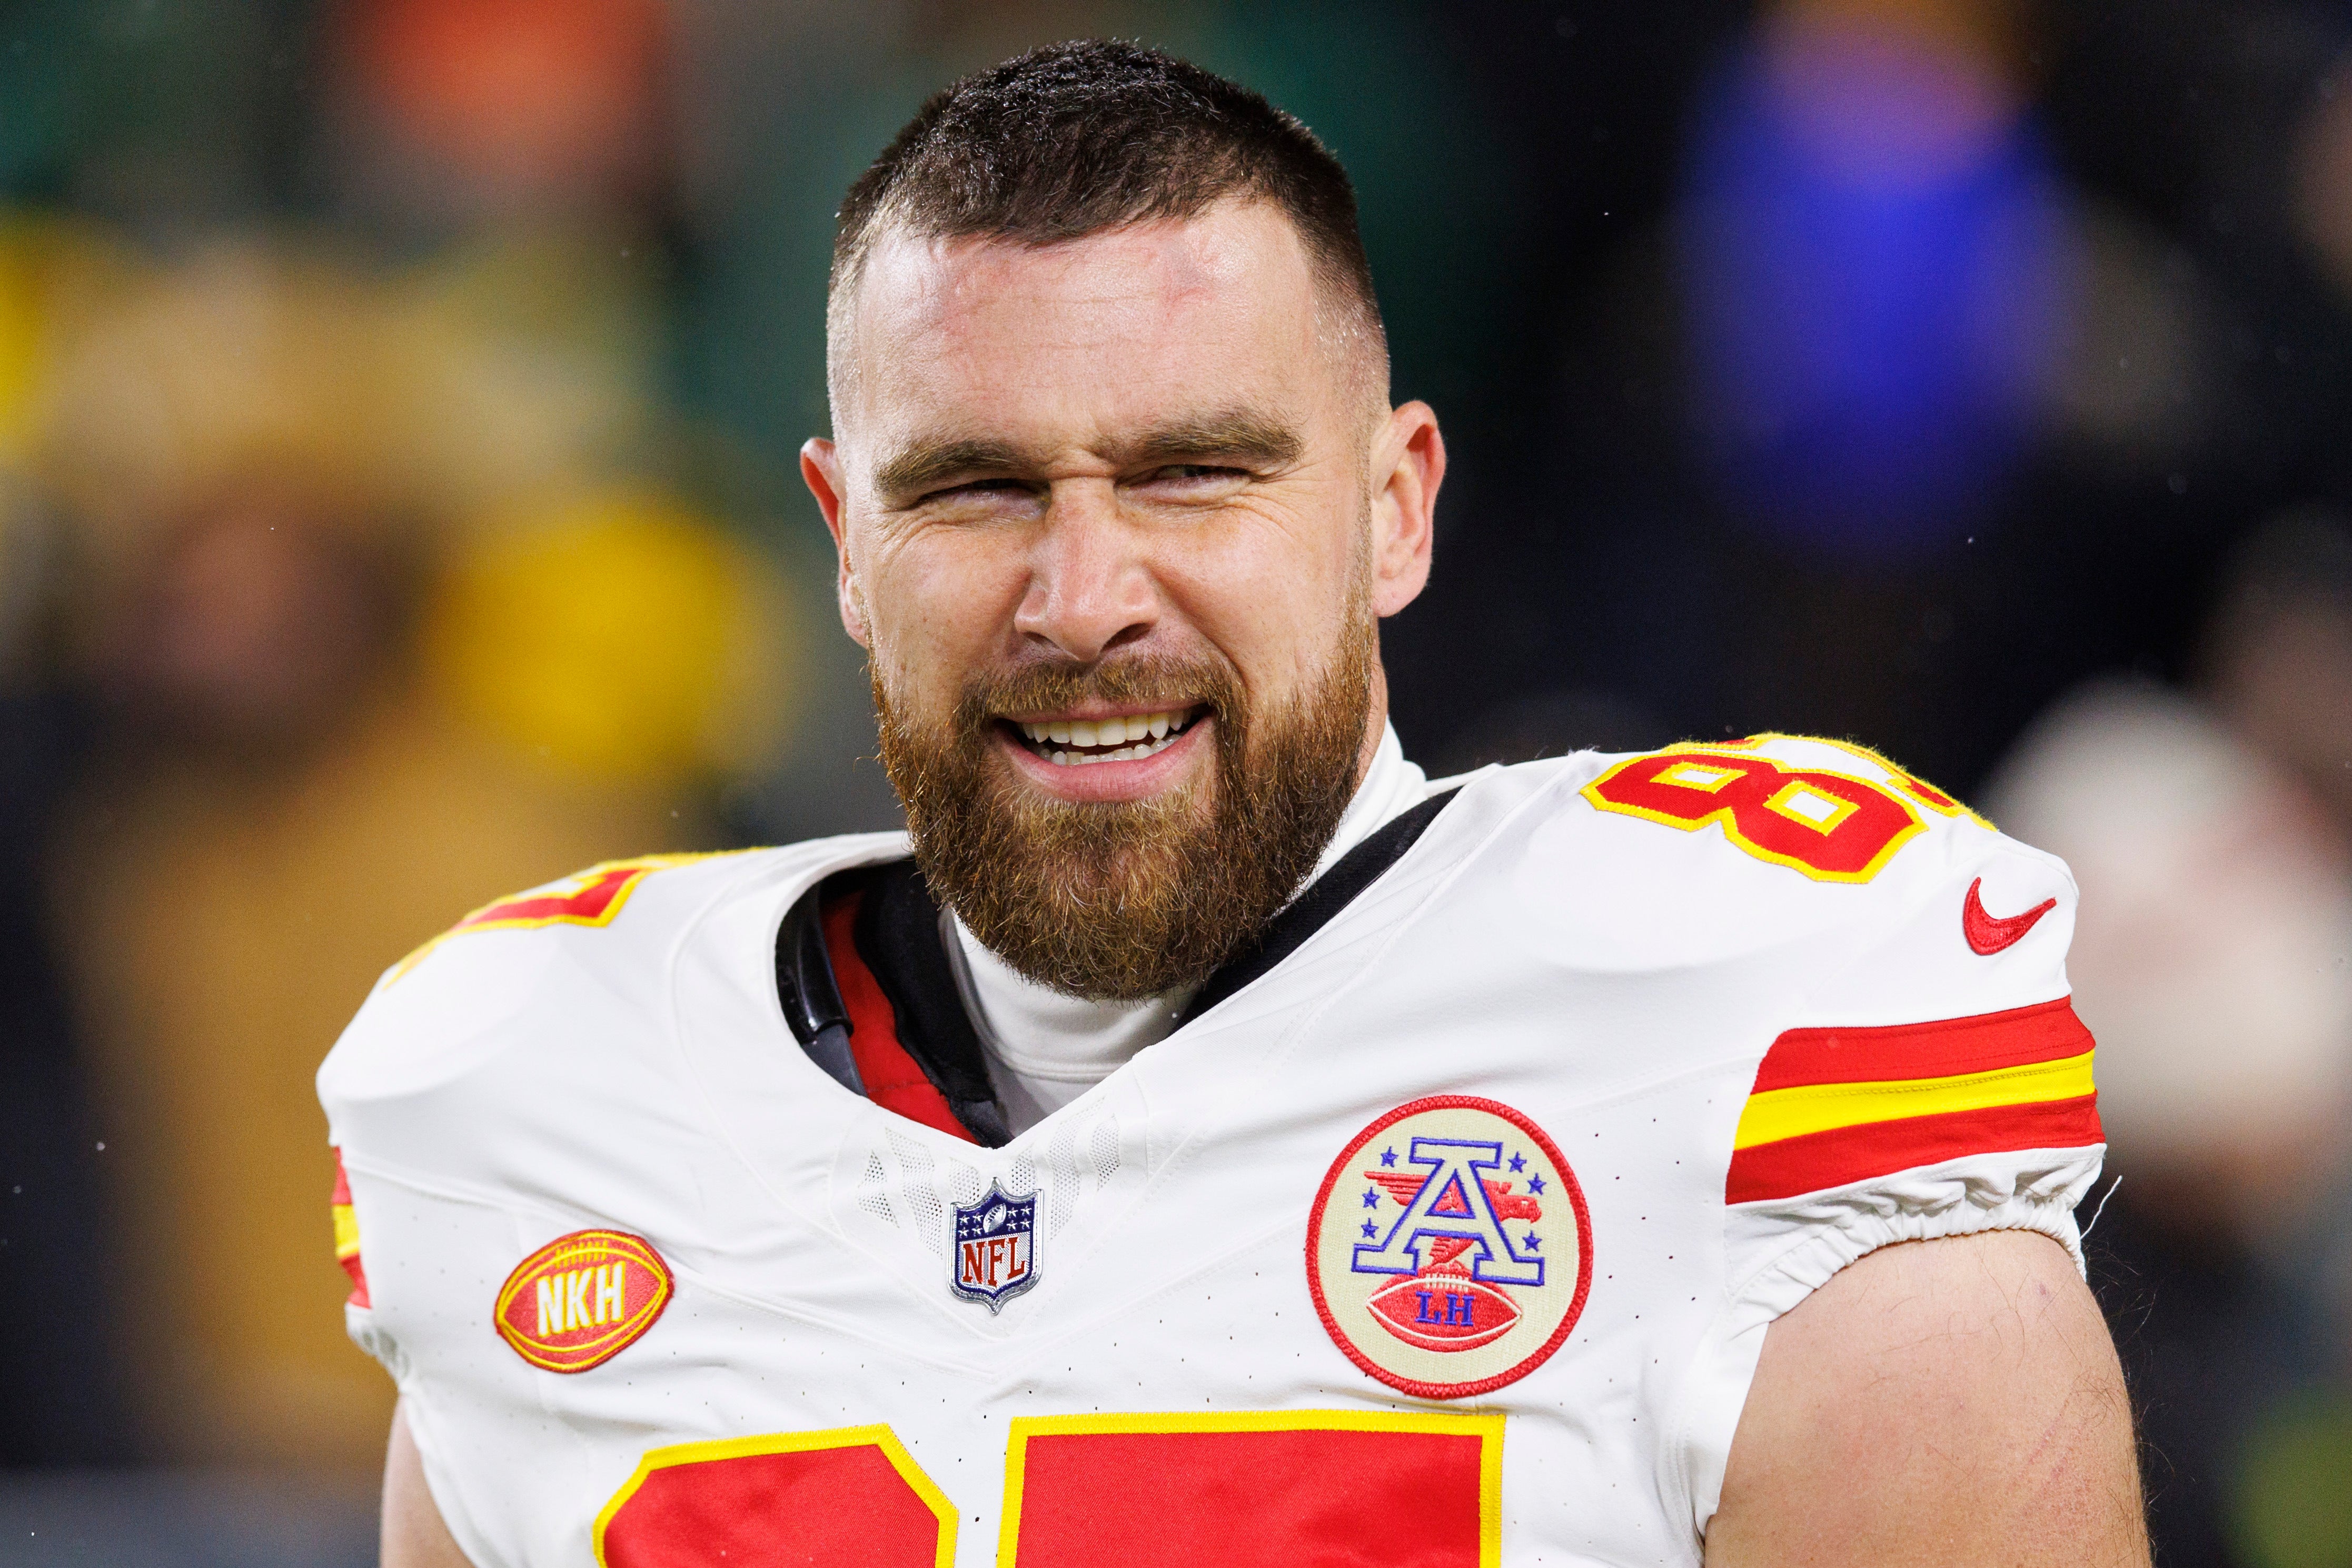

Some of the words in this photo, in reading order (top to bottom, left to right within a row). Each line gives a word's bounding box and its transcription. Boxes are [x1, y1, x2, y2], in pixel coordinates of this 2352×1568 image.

[1579, 732, 1998, 884] 8
[1351, 1137, 1544, 1285] A
[536, 1261, 626, 1338] NKH
[962, 1236, 1026, 1286] NFL
[1415, 1291, 1474, 1326] LH
